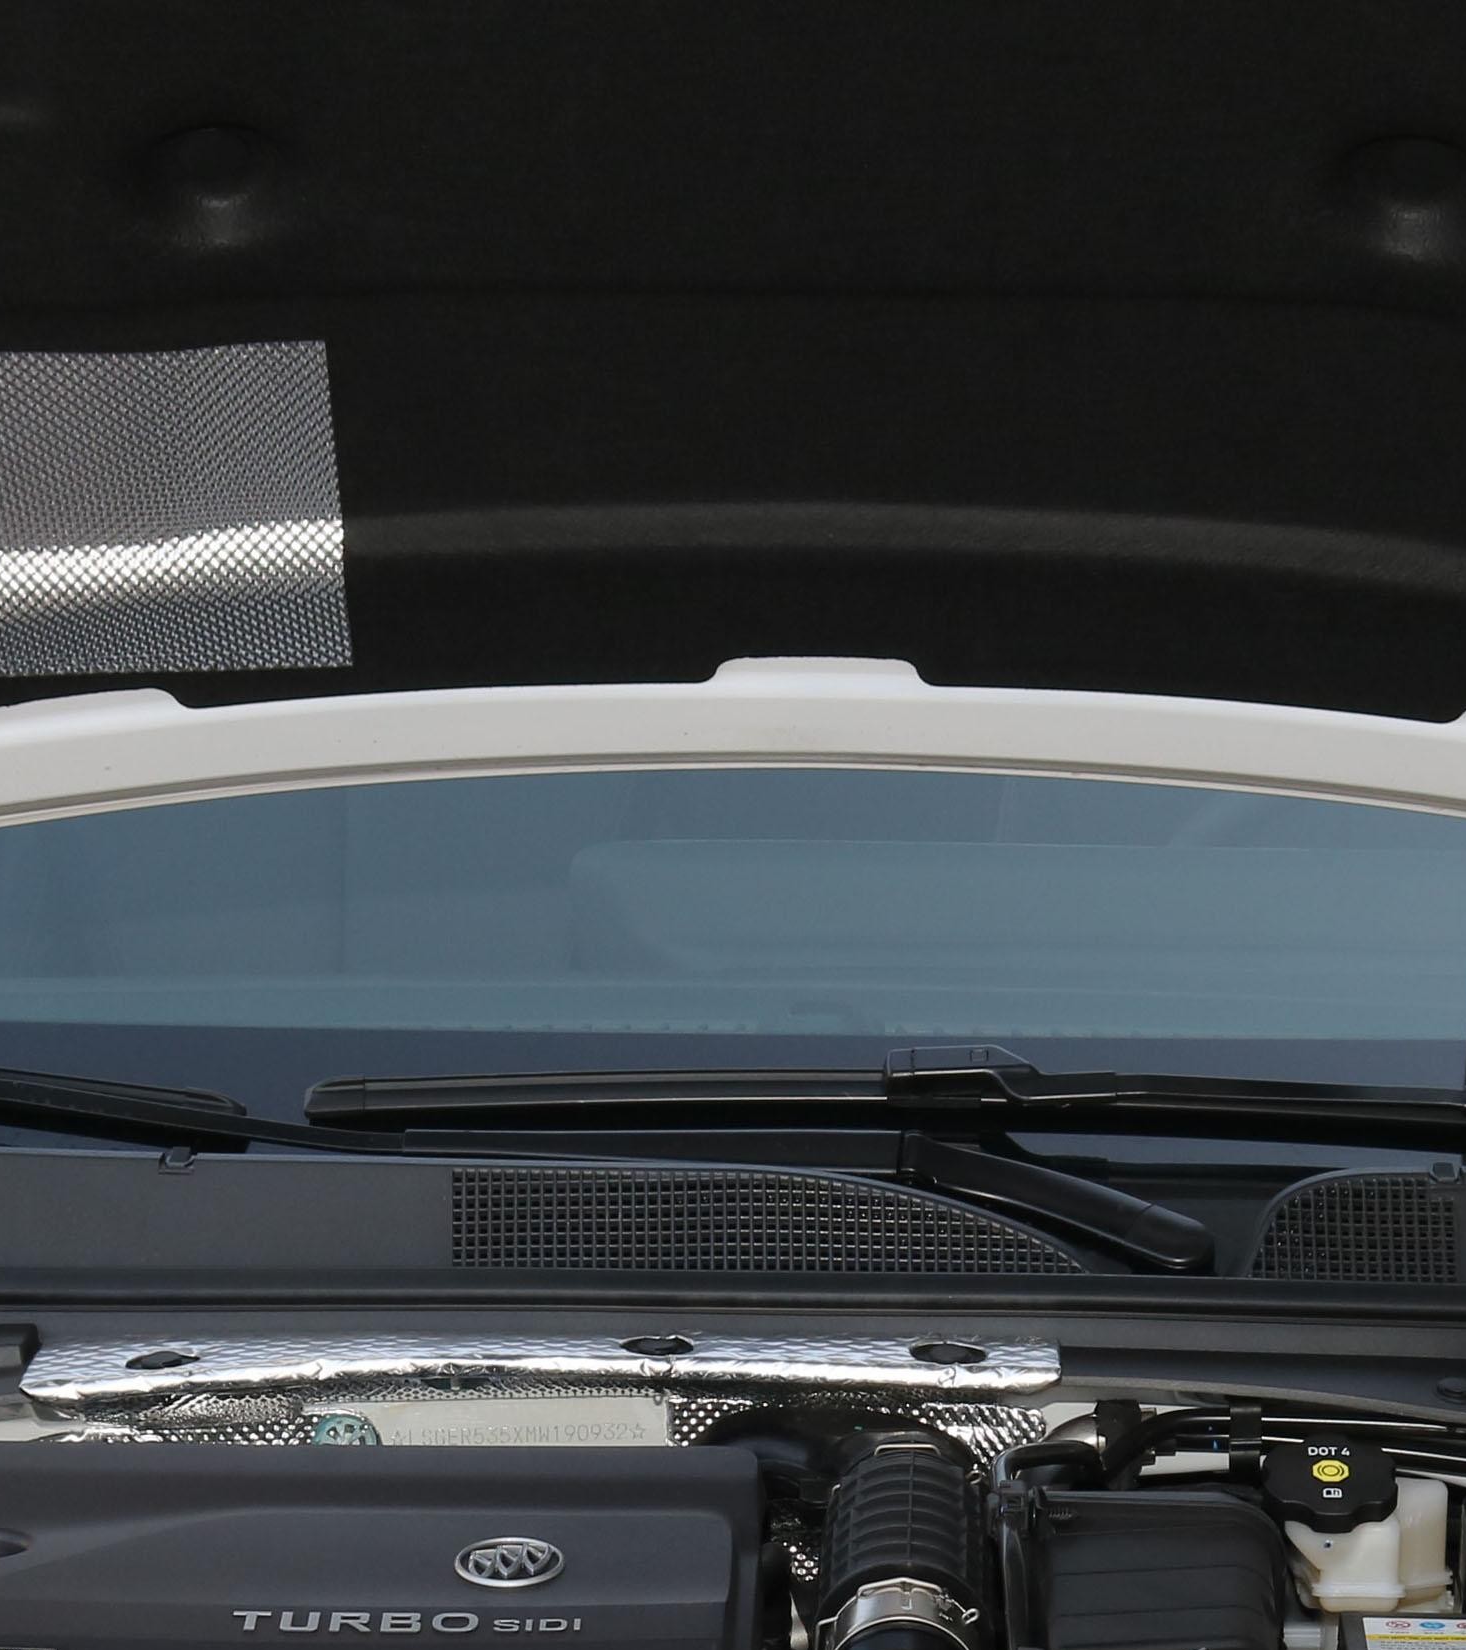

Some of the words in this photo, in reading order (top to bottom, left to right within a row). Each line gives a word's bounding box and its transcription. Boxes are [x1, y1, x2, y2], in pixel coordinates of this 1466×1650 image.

[1308, 1446, 1337, 1456] DOT
[1341, 1446, 1350, 1456] 4
[233, 1610, 480, 1633] TURBO
[492, 1617, 582, 1632] SIDI
